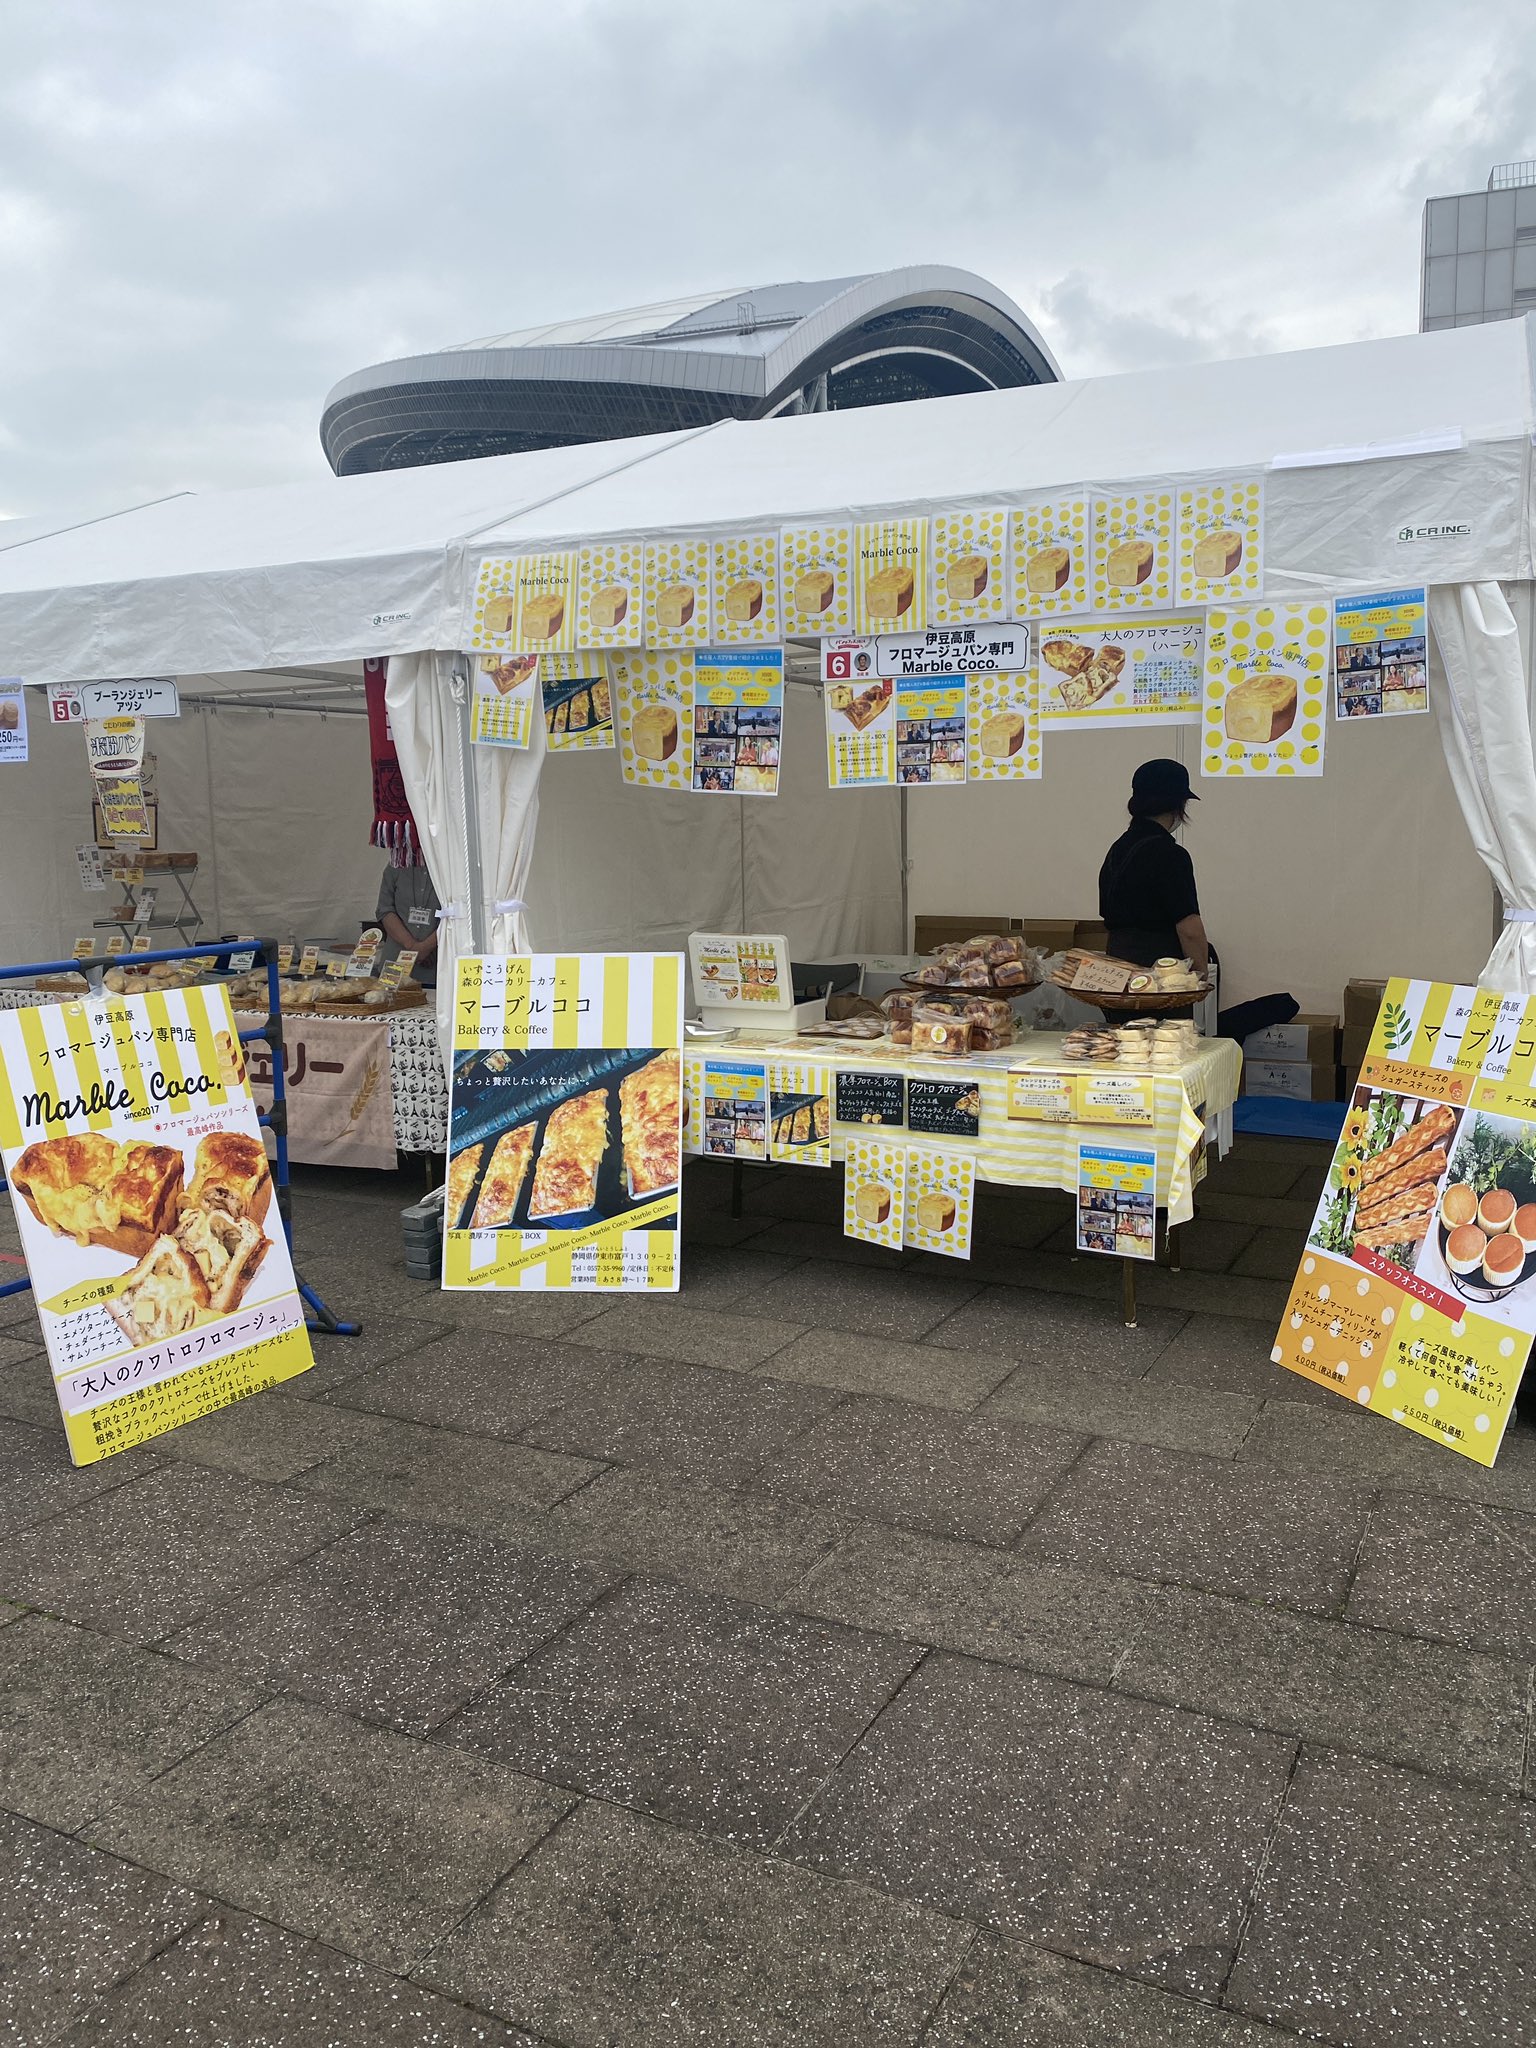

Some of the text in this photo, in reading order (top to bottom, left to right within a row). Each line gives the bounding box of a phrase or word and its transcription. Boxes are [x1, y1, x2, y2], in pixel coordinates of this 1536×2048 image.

[1417, 525, 1471, 536] CR INC.
[861, 548, 894, 559] Marble
[520, 576, 548, 586] Marble
[925, 630, 976, 646] 伊豆高原
[1100, 625, 1203, 642] 大人のフロマージュ
[889, 642, 1014, 661] フロマージュパン専門
[1214, 649, 1311, 669] フロマージュパン専門店
[832, 655, 845, 675] 6
[902, 659, 999, 673] Marble Coco.
[94, 689, 162, 702] ブーランジェリー
[56, 703, 65, 719] 5
[117, 701, 142, 712] アツシ
[91, 735, 141, 756] 米粉パン
[463, 964, 526, 975] いずこうげん
[462, 976, 567, 987] 森のベーカリーカフェ
[459, 995, 591, 1016] マーブルココ
[1484, 998, 1521, 1013] 伊豆高原
[95, 1010, 135, 1025] 伊豆高原
[458, 1024, 548, 1036] Bakery & Coffee
[39, 1027, 196, 1066] フロマージュパン専門店
[104, 1060, 153, 1074] マーブルココ
[1384, 1064, 1449, 1084] オレンジとチーズの
[1446, 1055, 1512, 1074] Bakery & Coffee
[1381, 1075, 1445, 1095] シュガースティック
[22, 1071, 222, 1127] Marble Coco.
[124, 1105, 160, 1121] since2017
[186, 1121, 224, 1137] 最高峰作品
[630, 1205, 671, 1225] Marble Coco.
[448, 1232, 541, 1240] 写真：濃厚フロマージュBOX
[590, 1218, 630, 1239] Marble Coco.
[549, 1232, 589, 1254] Marble Coco.
[508, 1250, 548, 1268] Marble Coco.
[467, 1265, 507, 1284] Marble Coco.
[1369, 1257, 1443, 1306] スタッフオススメ！
[63, 1283, 115, 1308] チーズの種類
[1304, 1291, 1377, 1326] オレンジマーマレードと
[1294, 1299, 1382, 1340] クリームチーズフィリングが
[1290, 1309, 1372, 1351] 入ったシュガーデニッシュ。
[1418, 1337, 1499, 1376] チーズ風味の蒸しパン
[1398, 1342, 1506, 1396] 軽くて何個でも食べれちゃう。
[1398, 1355, 1502, 1406] 冷やして食べても美味しい！
